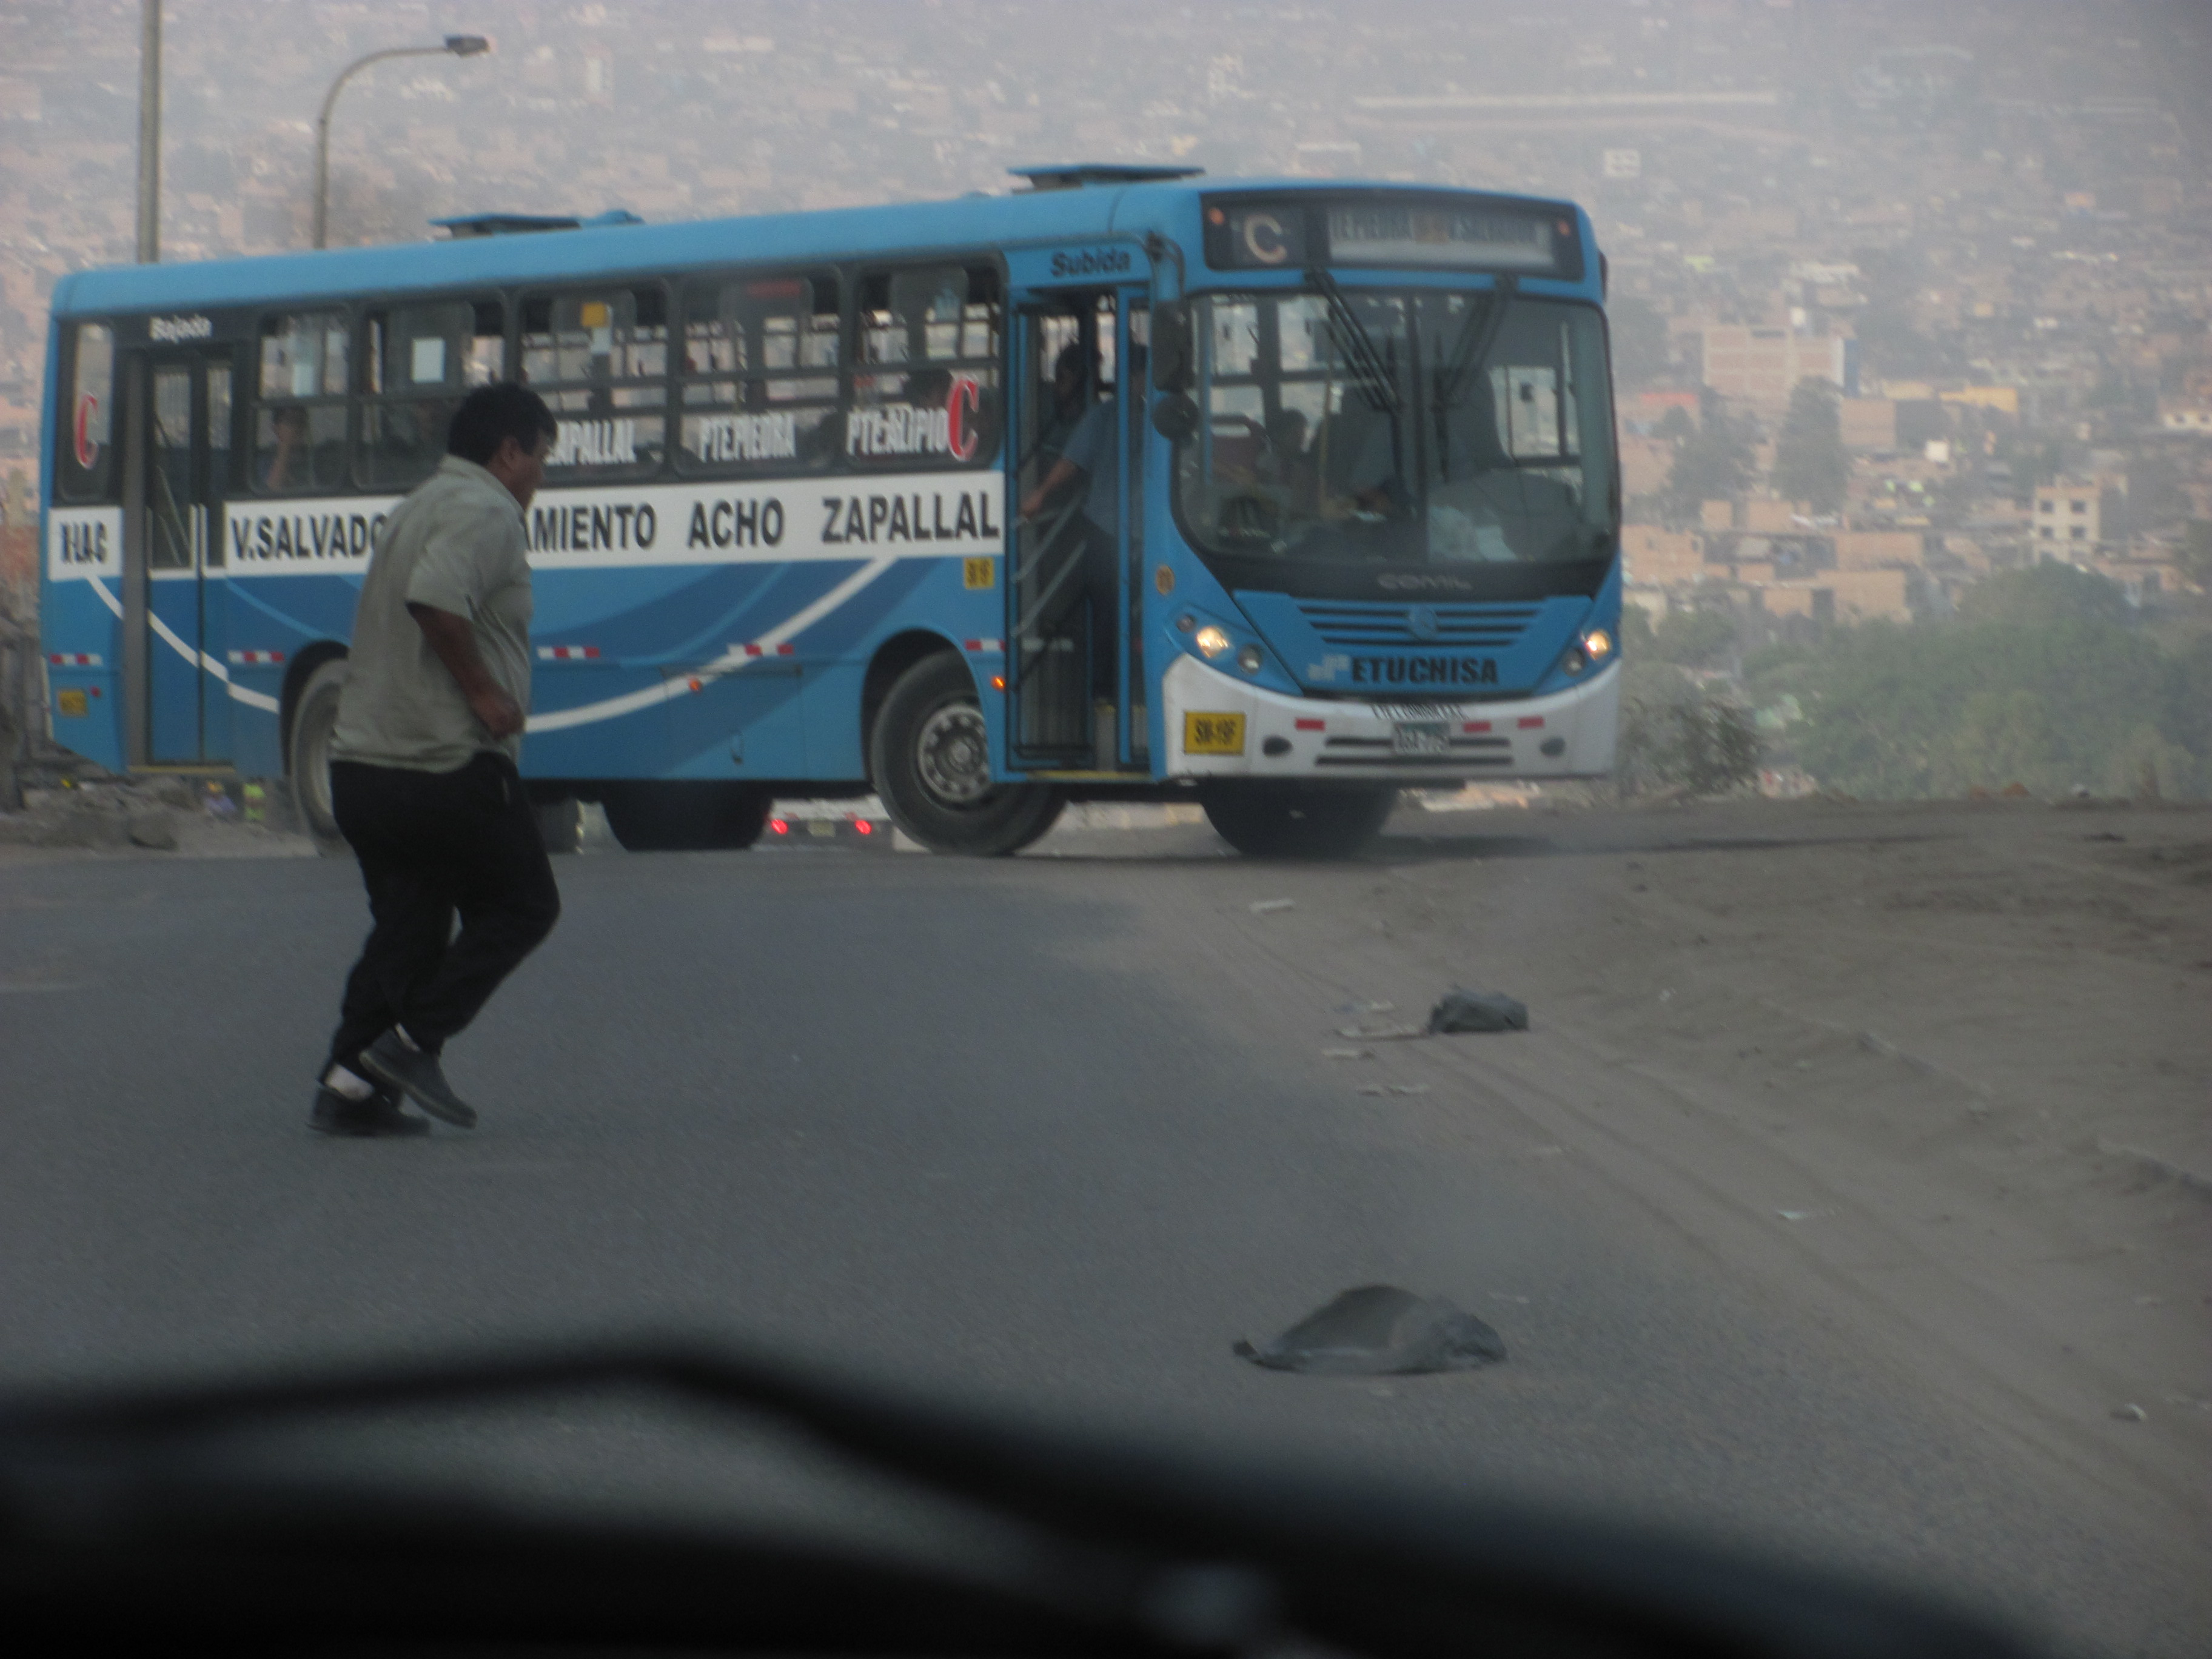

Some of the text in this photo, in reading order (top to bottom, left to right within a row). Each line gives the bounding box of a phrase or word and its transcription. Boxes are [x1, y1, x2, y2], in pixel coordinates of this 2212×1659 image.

[1050, 248, 1130, 277] Subida
[1243, 214, 1288, 264] C
[946, 377, 980, 462] C
[688, 496, 785, 549] ACHO
[820, 491, 1000, 545] ZAPALLAL
